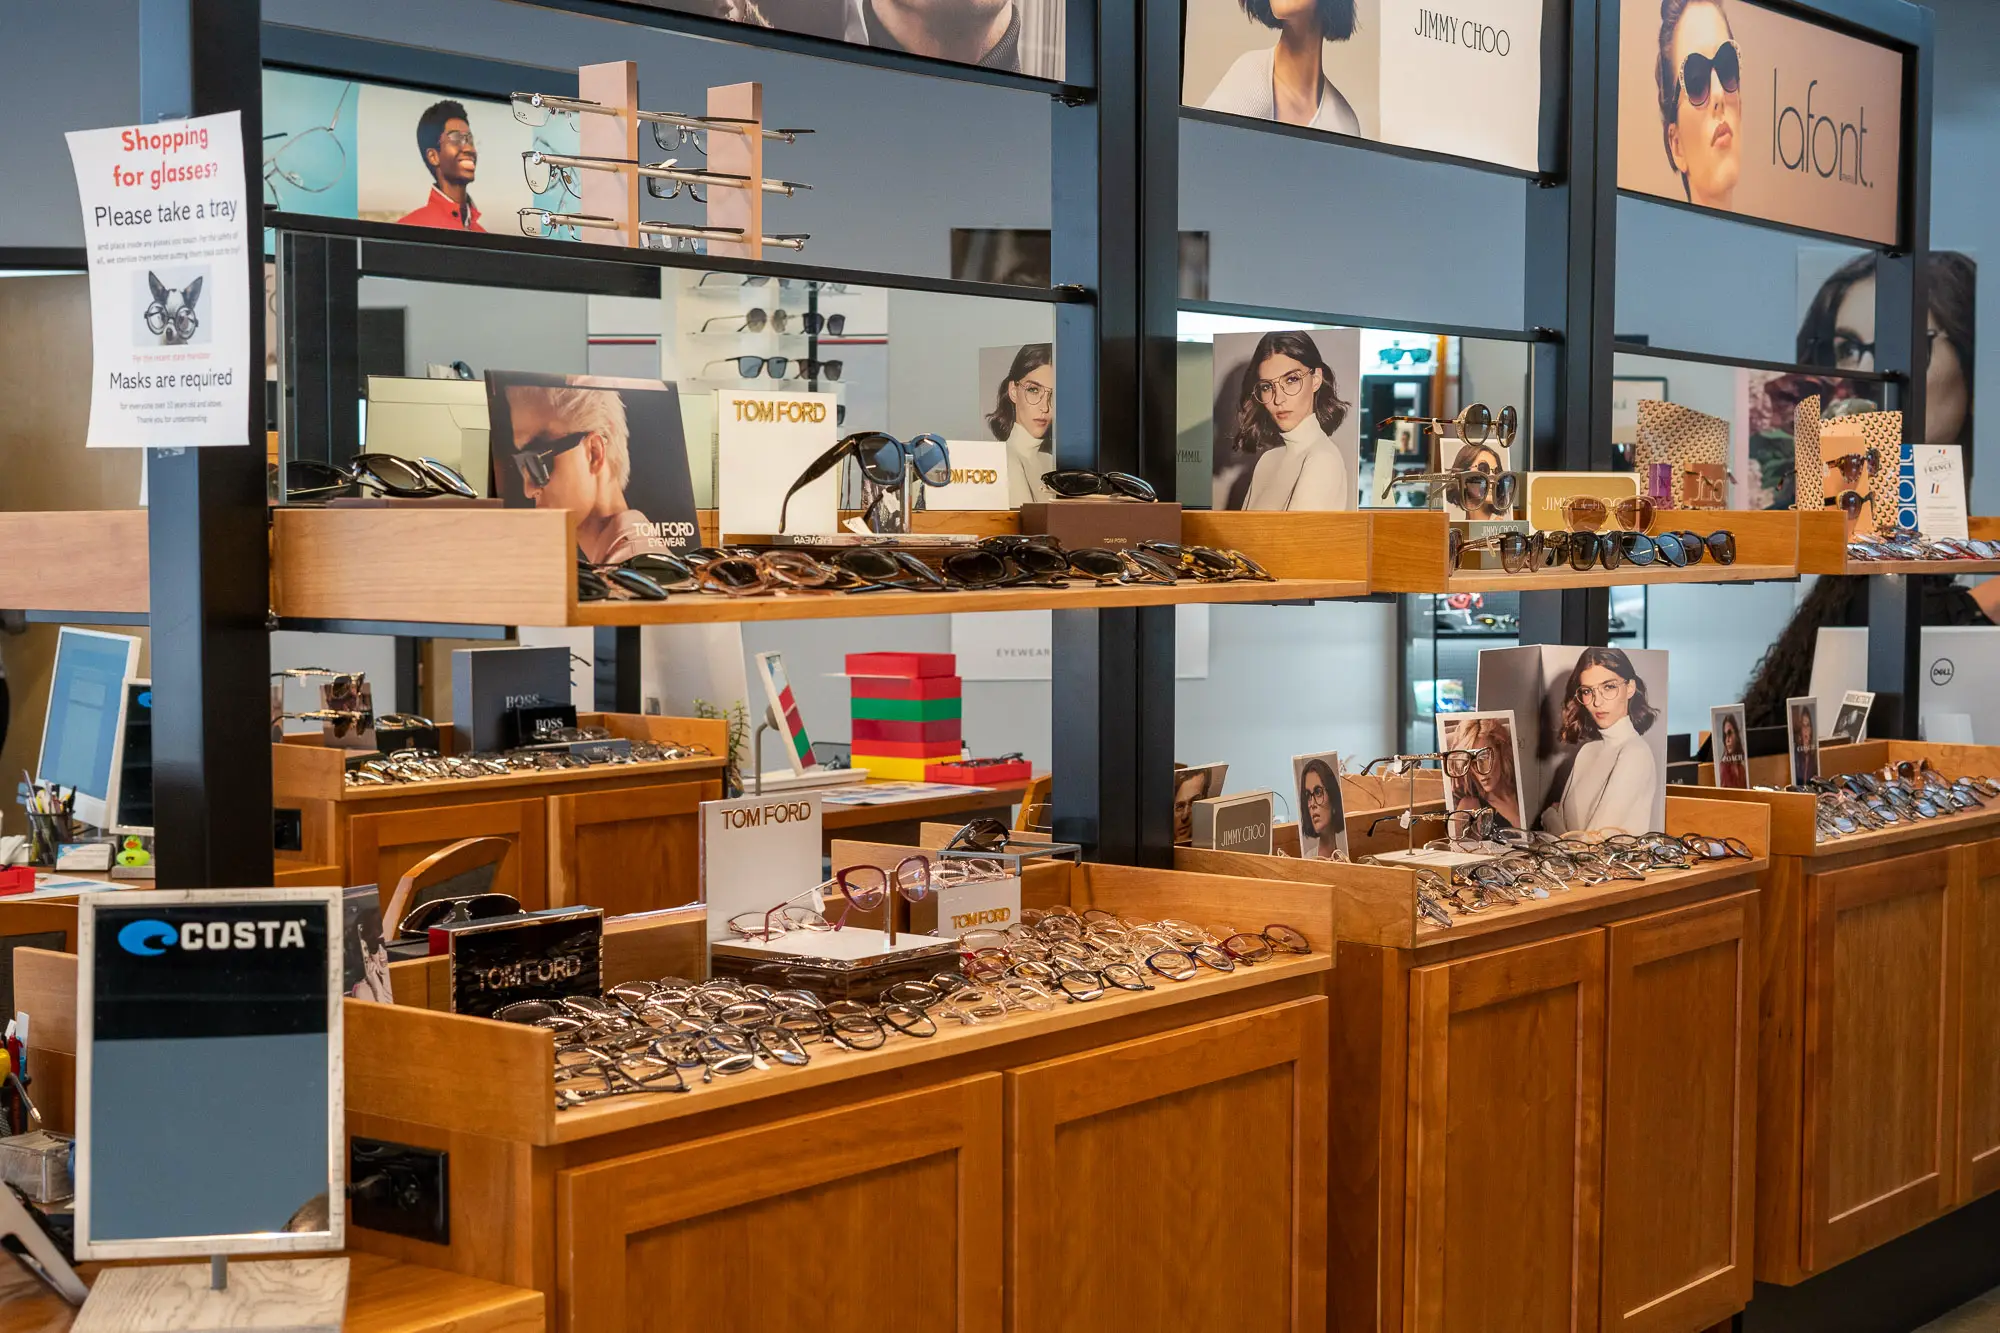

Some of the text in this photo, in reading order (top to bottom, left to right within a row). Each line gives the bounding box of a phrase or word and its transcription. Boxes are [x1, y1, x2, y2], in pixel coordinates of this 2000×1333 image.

[1414, 8, 1510, 56] JIMMY CHOO
[121, 123, 208, 154] Shopping
[113, 161, 218, 190] for glasses?
[94, 198, 238, 227] Please take a tray
[110, 368, 233, 392] Masks are required
[732, 400, 827, 423] TOM FORD
[965, 469, 998, 485] FORD
[632, 522, 695, 537] TOM FORD
[648, 537, 687, 548] EYEWEAR
[996, 647, 1050, 658] EYEWEAR
[505, 693, 541, 709] BOSS
[535, 717, 565, 732] BOSS
[721, 801, 812, 830] TOM FORD
[1221, 822, 1266, 847] JIMMY CHOO
[951, 907, 1011, 929] TOM FORD
[180, 919, 306, 950] COSTA
[474, 954, 581, 992] TOM FORD
